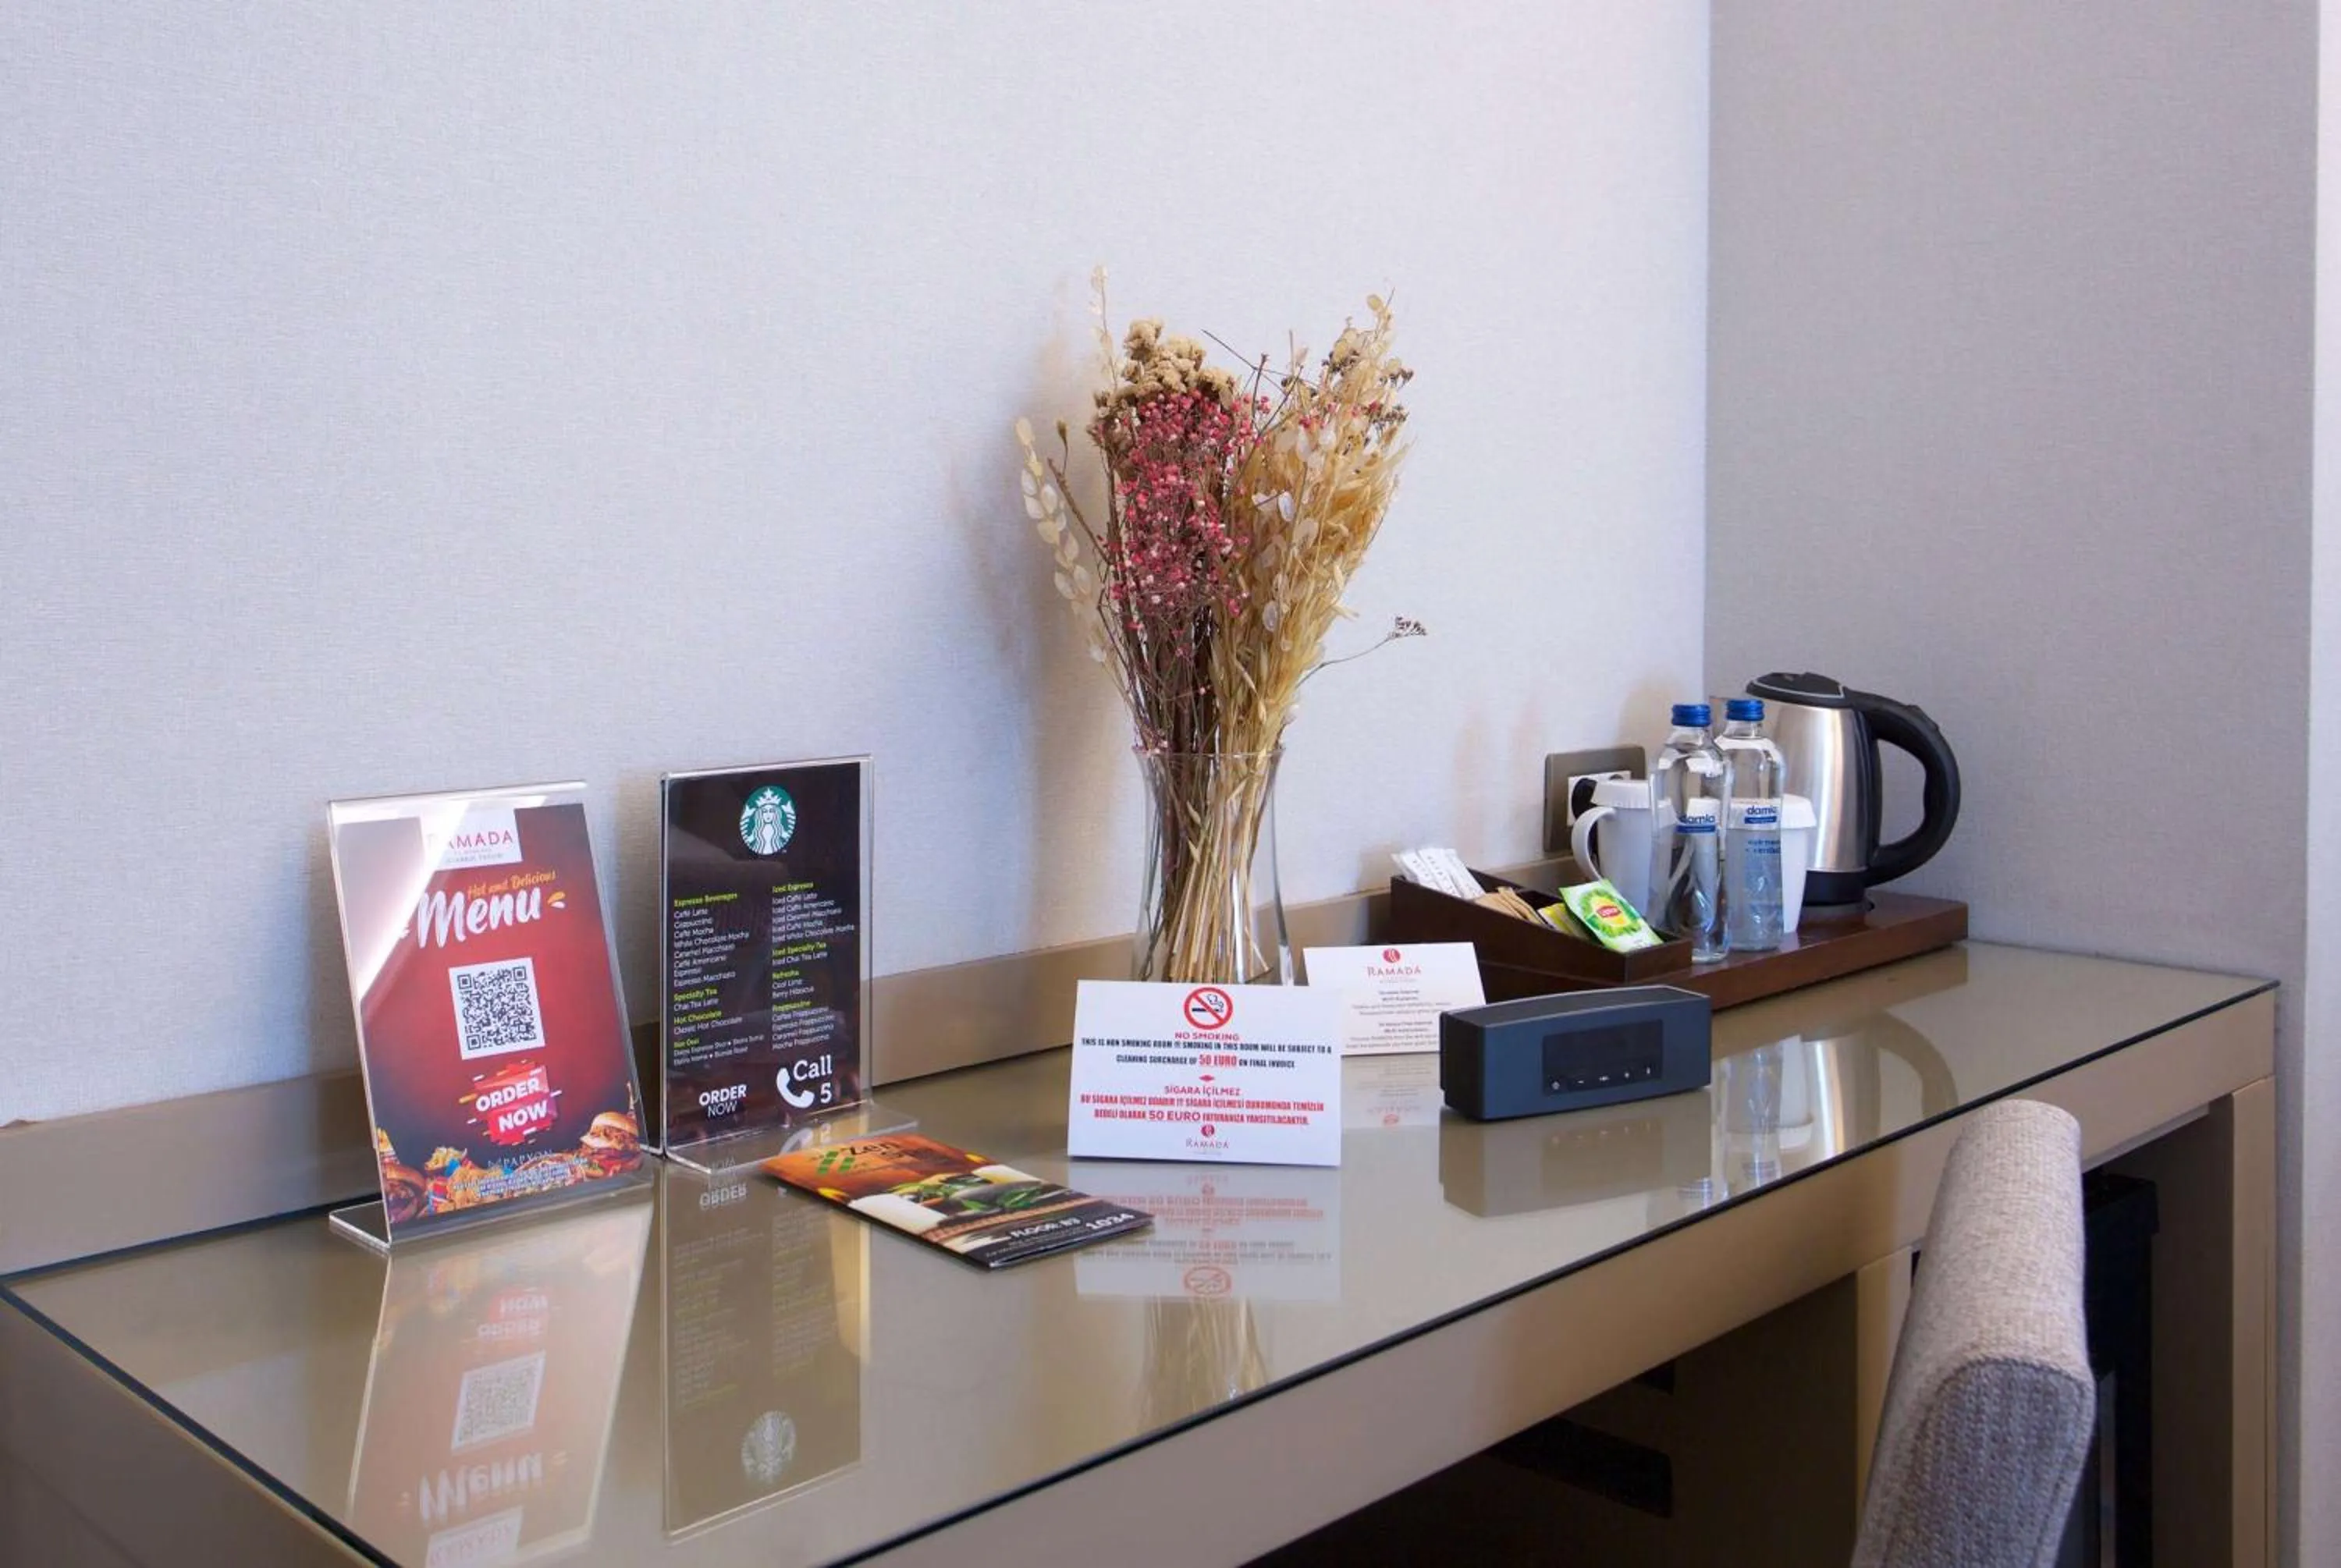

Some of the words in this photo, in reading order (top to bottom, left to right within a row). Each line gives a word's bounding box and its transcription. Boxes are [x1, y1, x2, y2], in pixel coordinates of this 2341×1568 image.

[467, 882, 487, 900] Hot
[489, 880, 509, 894] and
[510, 870, 557, 889] Delicious
[416, 886, 542, 949] Menu
[692, 928, 714, 936] Mocha
[1366, 964, 1422, 978] RAMADA
[1174, 1031, 1190, 1040] NO
[1192, 1032, 1239, 1041] SMOKING
[1082, 1038, 1096, 1046] THIS
[1121, 1038, 1151, 1048] SMOKING
[1153, 1040, 1173, 1048] ROOM
[1183, 1041, 1213, 1049] SMOKING
[1214, 1041, 1221, 1050] IN
[1224, 1042, 1238, 1051] THIS
[1240, 1043, 1259, 1052] ROOM
[1261, 1044, 1276, 1052] WILL
[1277, 1044, 1285, 1052] BE
[1288, 1045, 1316, 1053] SUBJECT
[793, 1054, 833, 1081] Call
[1149, 1055, 1188, 1065] SURCHARGE
[1188, 1056, 1198, 1065] OF
[1199, 1054, 1212, 1066] 50
[1213, 1054, 1238, 1067] EURO
[1239, 1058, 1248, 1066] ON
[1249, 1059, 1266, 1067] FINAL
[1268, 1059, 1295, 1069] INVOICE
[475, 1077, 539, 1112] ORDER
[698, 1084, 747, 1106] ORDER
[820, 1082, 832, 1103] 5
[1081, 1094, 1091, 1103] BU
[498, 1099, 548, 1133] NOW
[708, 1100, 737, 1118] NOW
[1148, 1110, 1164, 1120] 50
[1167, 1110, 1201, 1121] EURO
[1185, 1137, 1229, 1149] RAMADA
